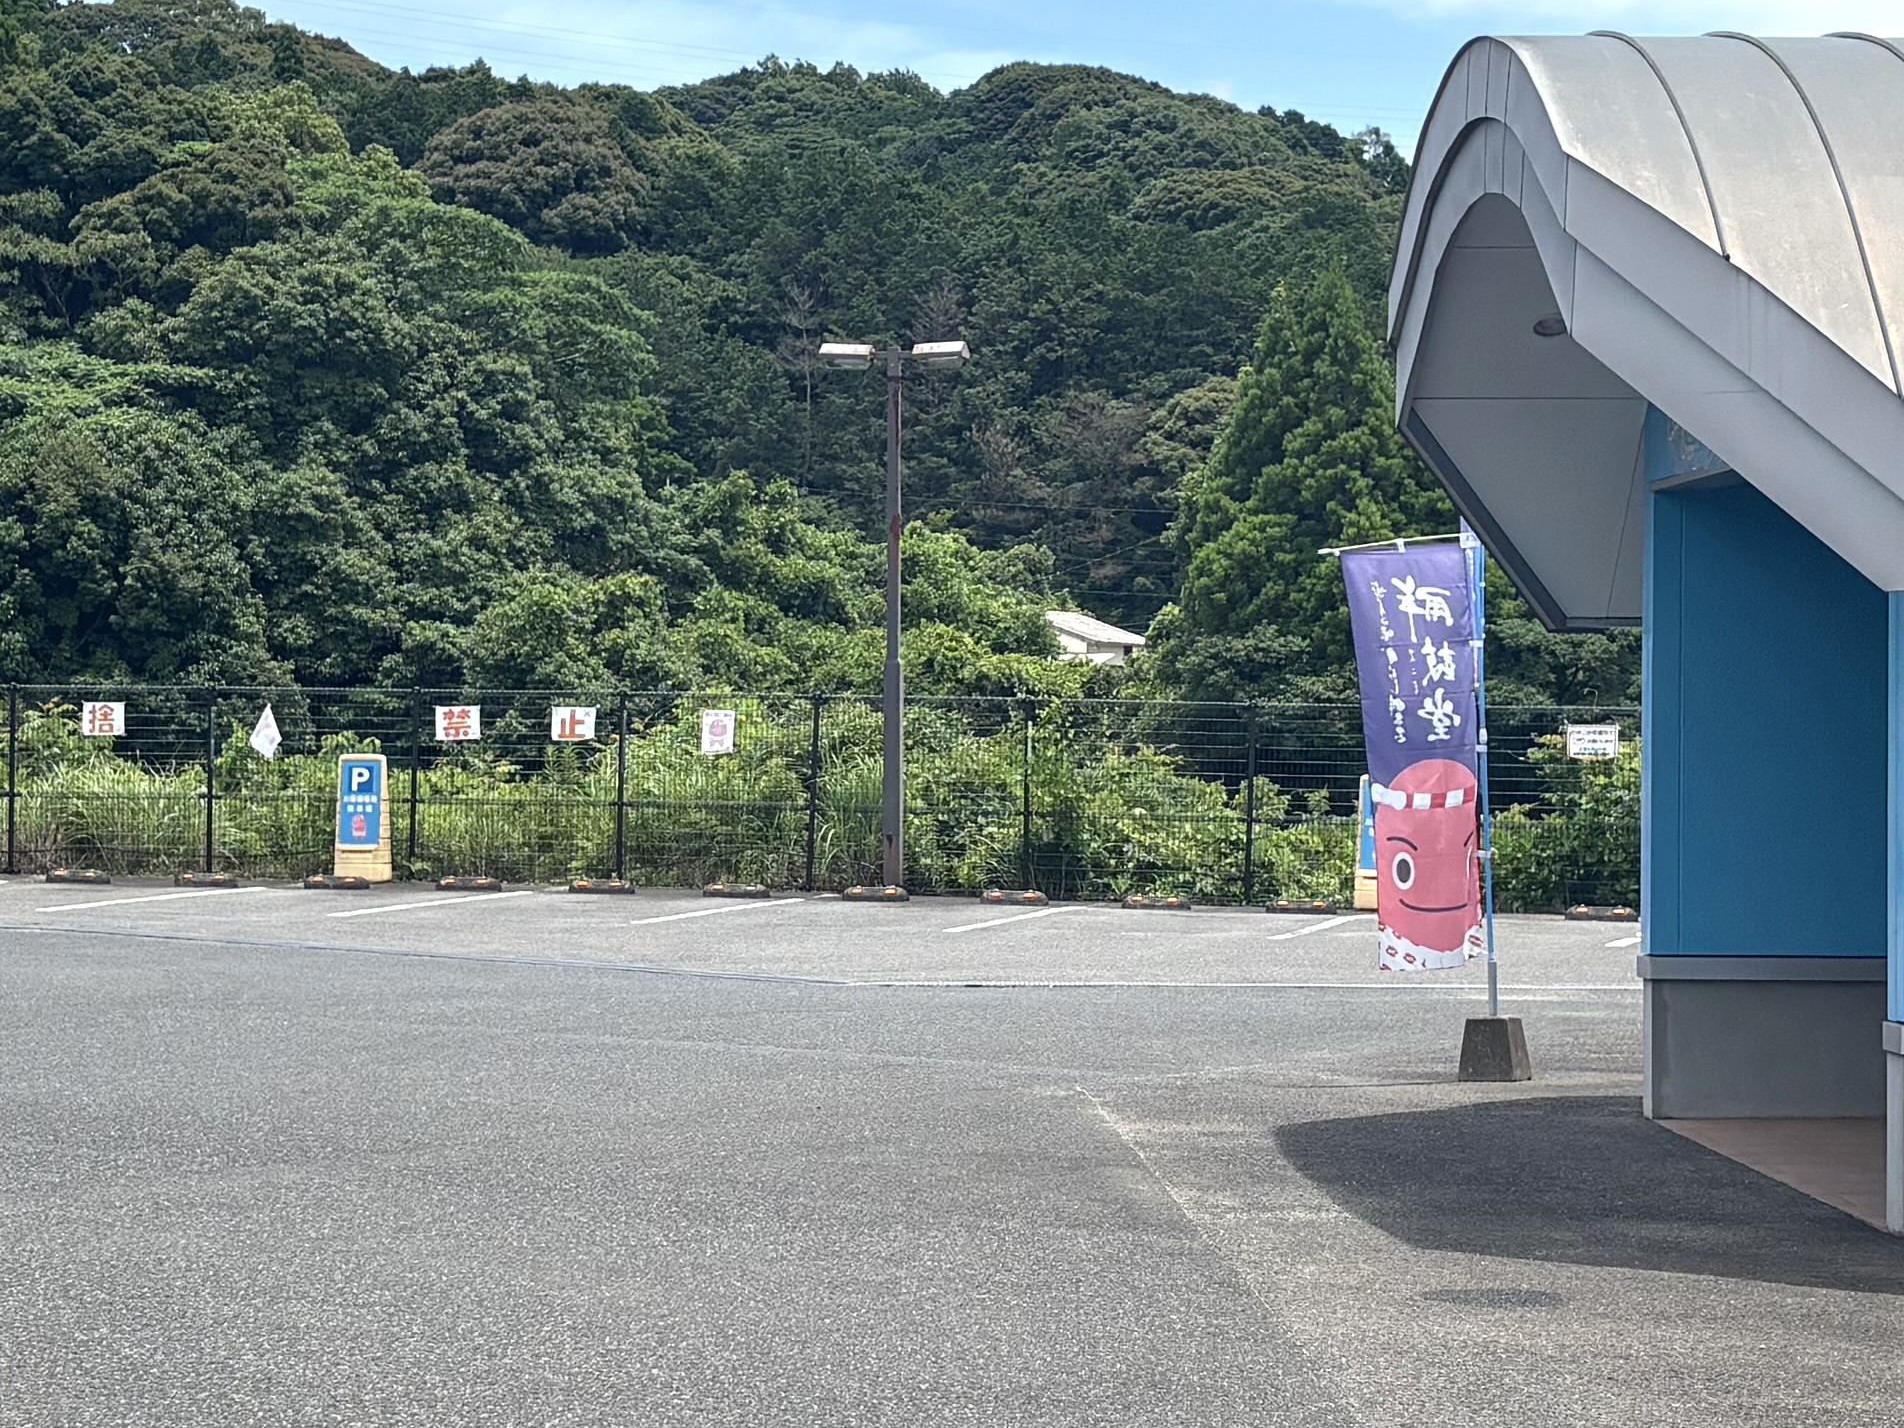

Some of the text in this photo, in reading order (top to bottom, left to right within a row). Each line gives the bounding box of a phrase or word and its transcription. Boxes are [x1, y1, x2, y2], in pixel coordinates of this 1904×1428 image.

[88, 704, 115, 733] 捨
[442, 708, 472, 738] 禁
[558, 709, 586, 739] 止
[351, 767, 370, 791] P
